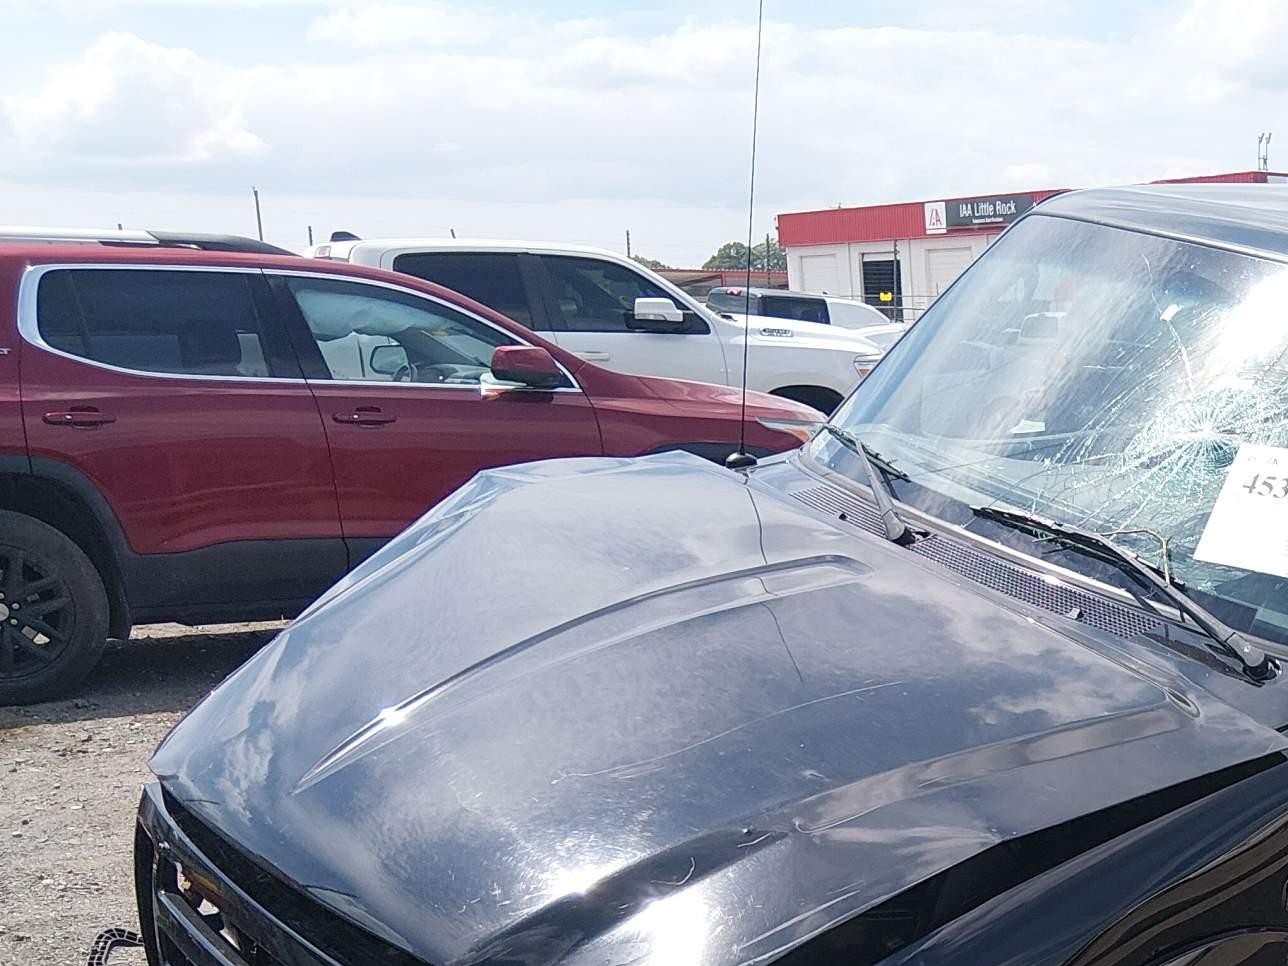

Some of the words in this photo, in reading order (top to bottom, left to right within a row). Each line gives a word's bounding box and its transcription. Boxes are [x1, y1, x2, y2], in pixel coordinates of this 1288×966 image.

[959, 203, 973, 217] IAA
[974, 201, 994, 217] Little
[995, 200, 1017, 215] Rock
